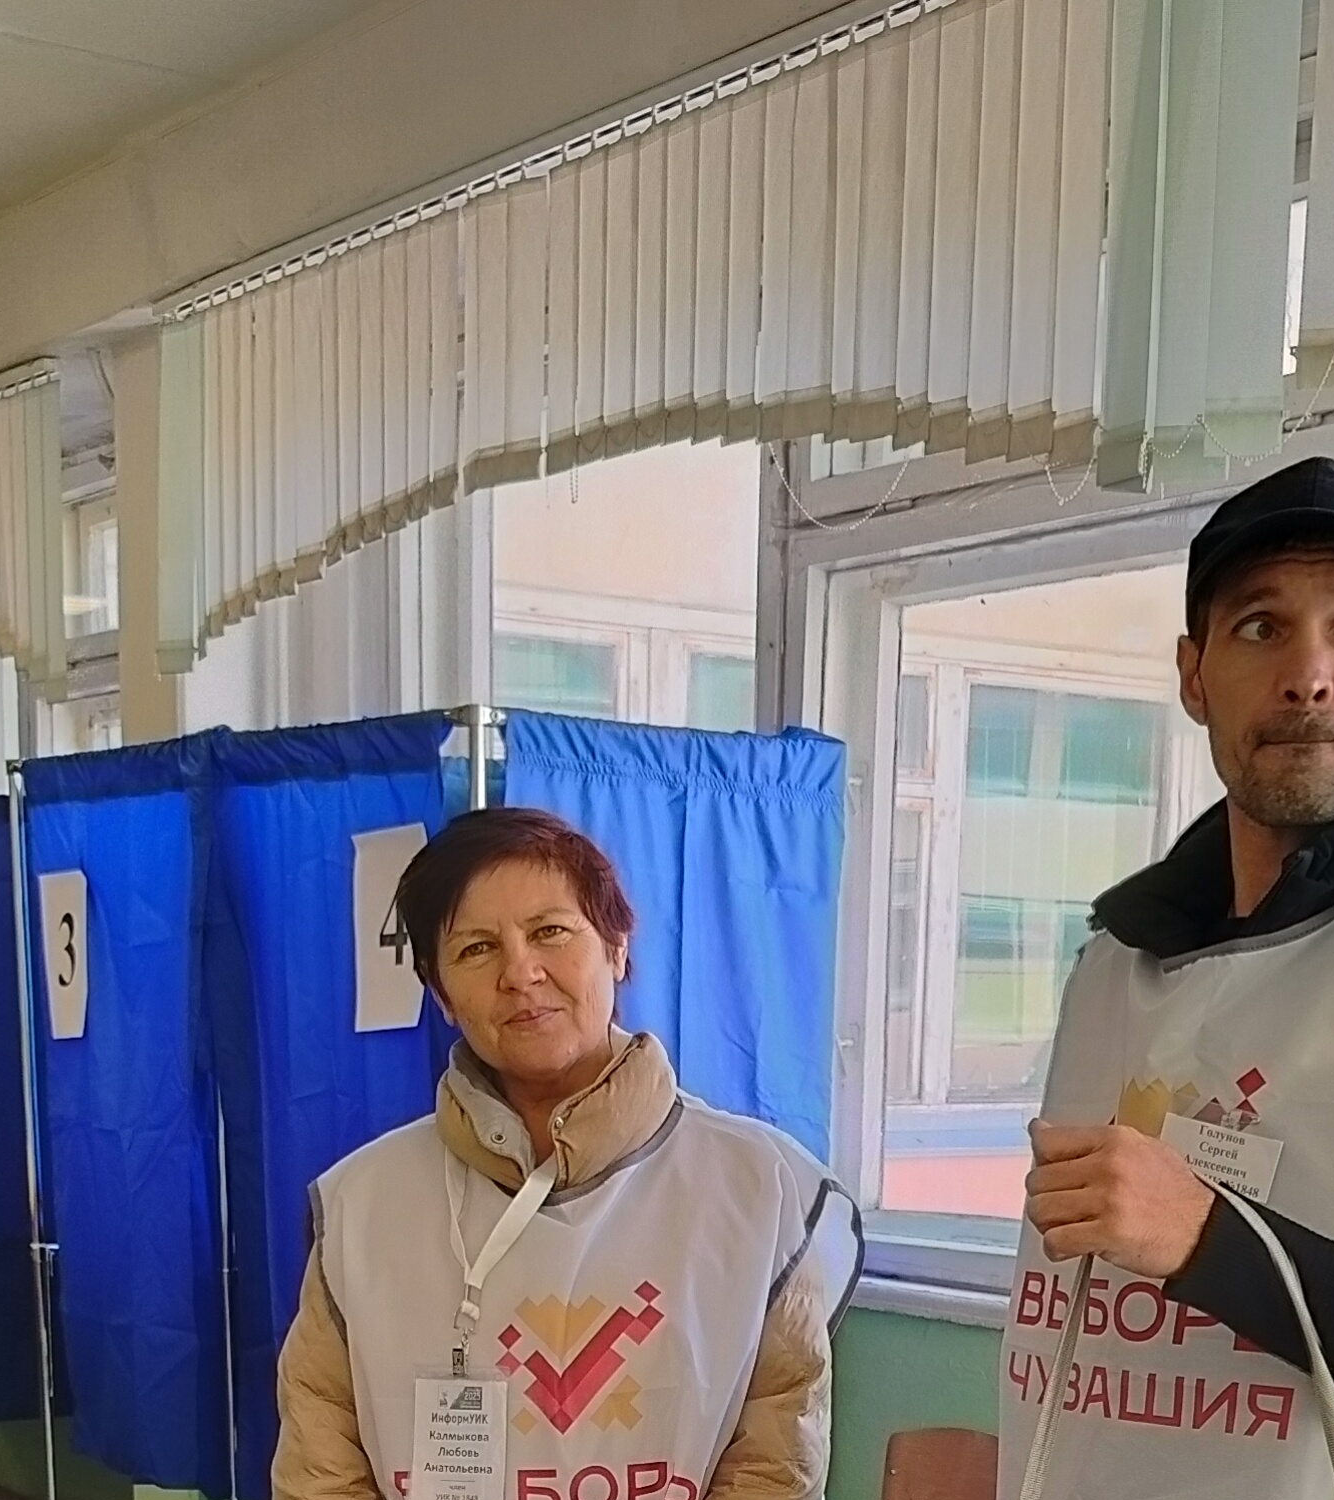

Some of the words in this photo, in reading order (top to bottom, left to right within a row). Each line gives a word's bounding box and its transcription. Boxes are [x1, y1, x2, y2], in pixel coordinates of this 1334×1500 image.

[379, 880, 409, 966] 4
[58, 912, 77, 988] 3
[1199, 1125, 1246, 1146] Голунов
[1199, 1141, 1238, 1160] Сергей
[1184, 1154, 1247, 1179] Алексеевич
[1016, 1270, 1267, 1354] ВЫБОР
[1009, 1351, 1295, 1440] ЧУВАШИЯ
[431, 1412, 489, 1425] ИнформУИК
[429, 1430, 490, 1442] Калмыкова
[437, 1446, 479, 1458] Любовь
[424, 1462, 493, 1474] Анатольевна
